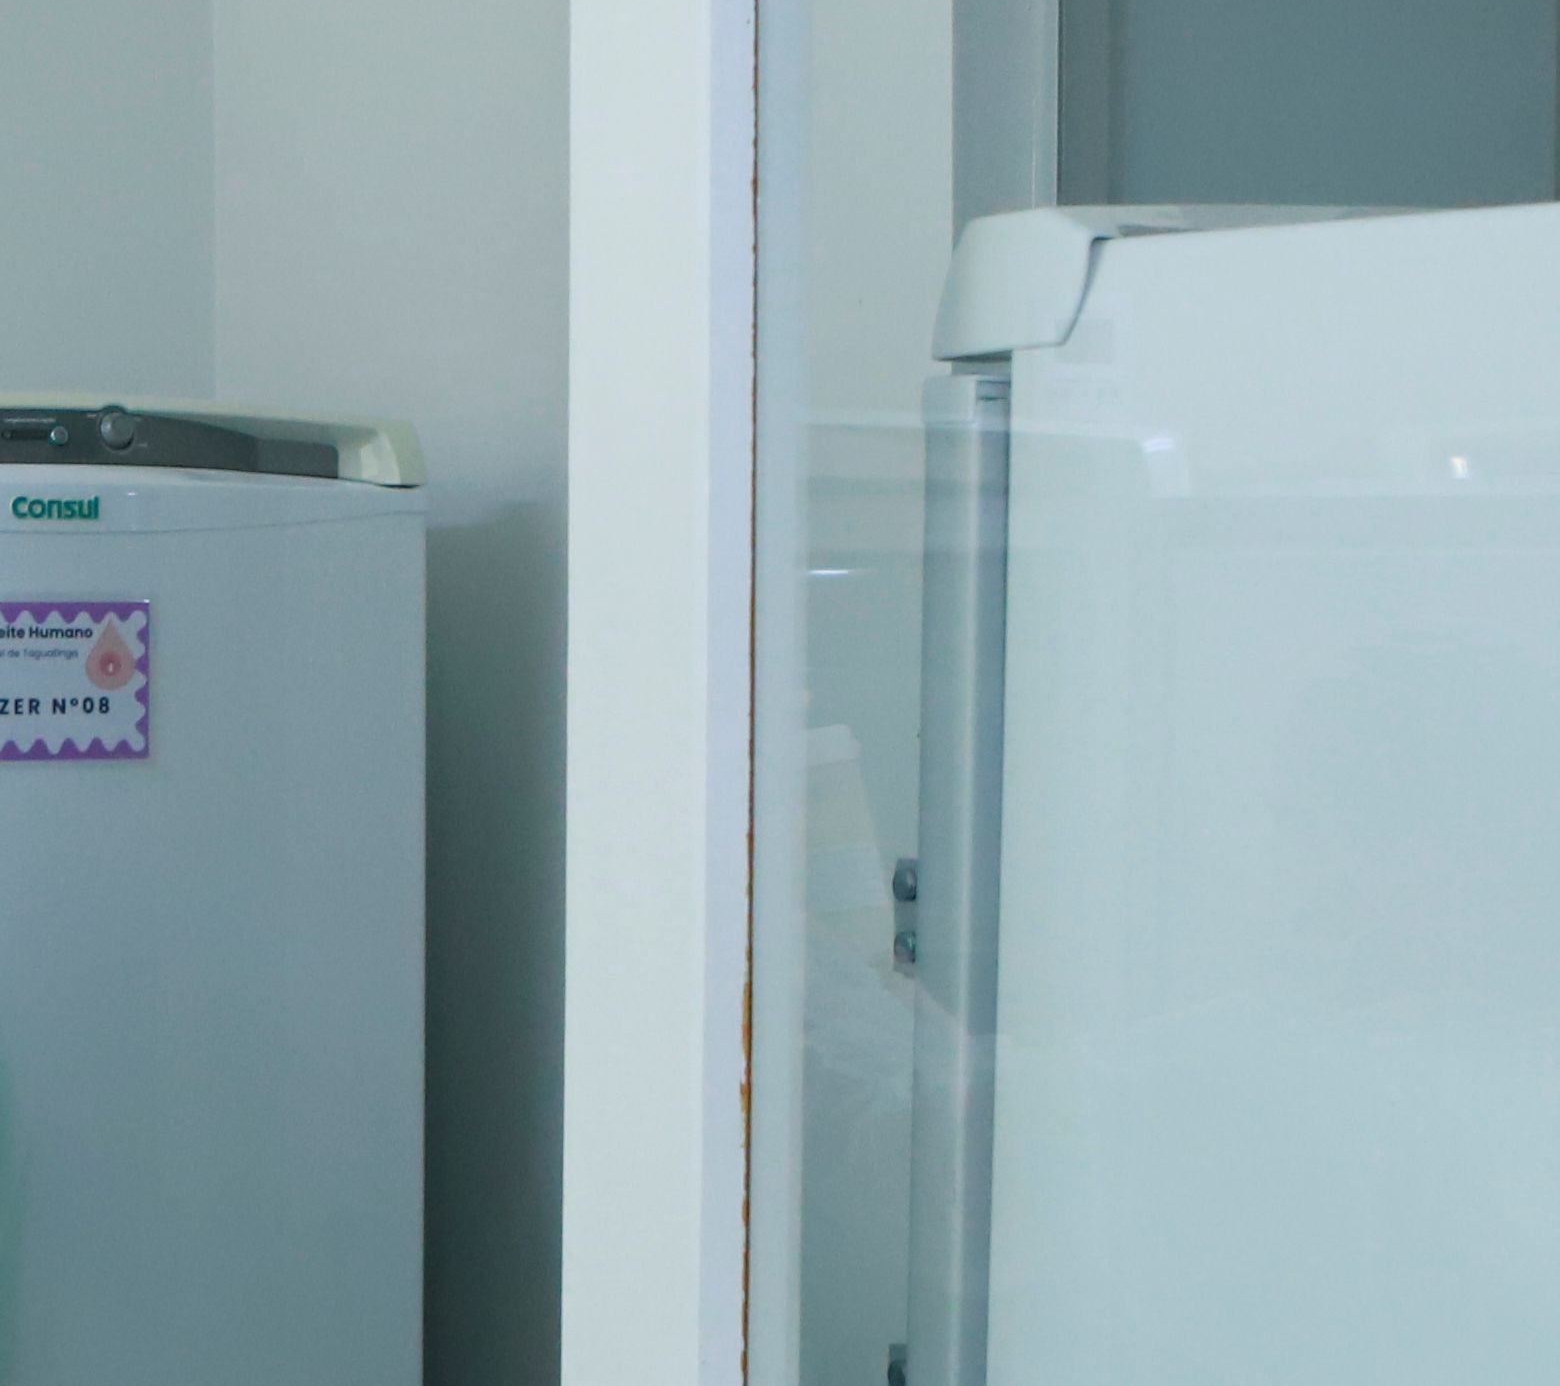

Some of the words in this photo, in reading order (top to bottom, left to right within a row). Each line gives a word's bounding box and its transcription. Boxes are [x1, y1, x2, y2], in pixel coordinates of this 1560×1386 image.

[11, 496, 100, 520] Consul
[29, 625, 93, 639] Humano
[7, 649, 20, 659] de
